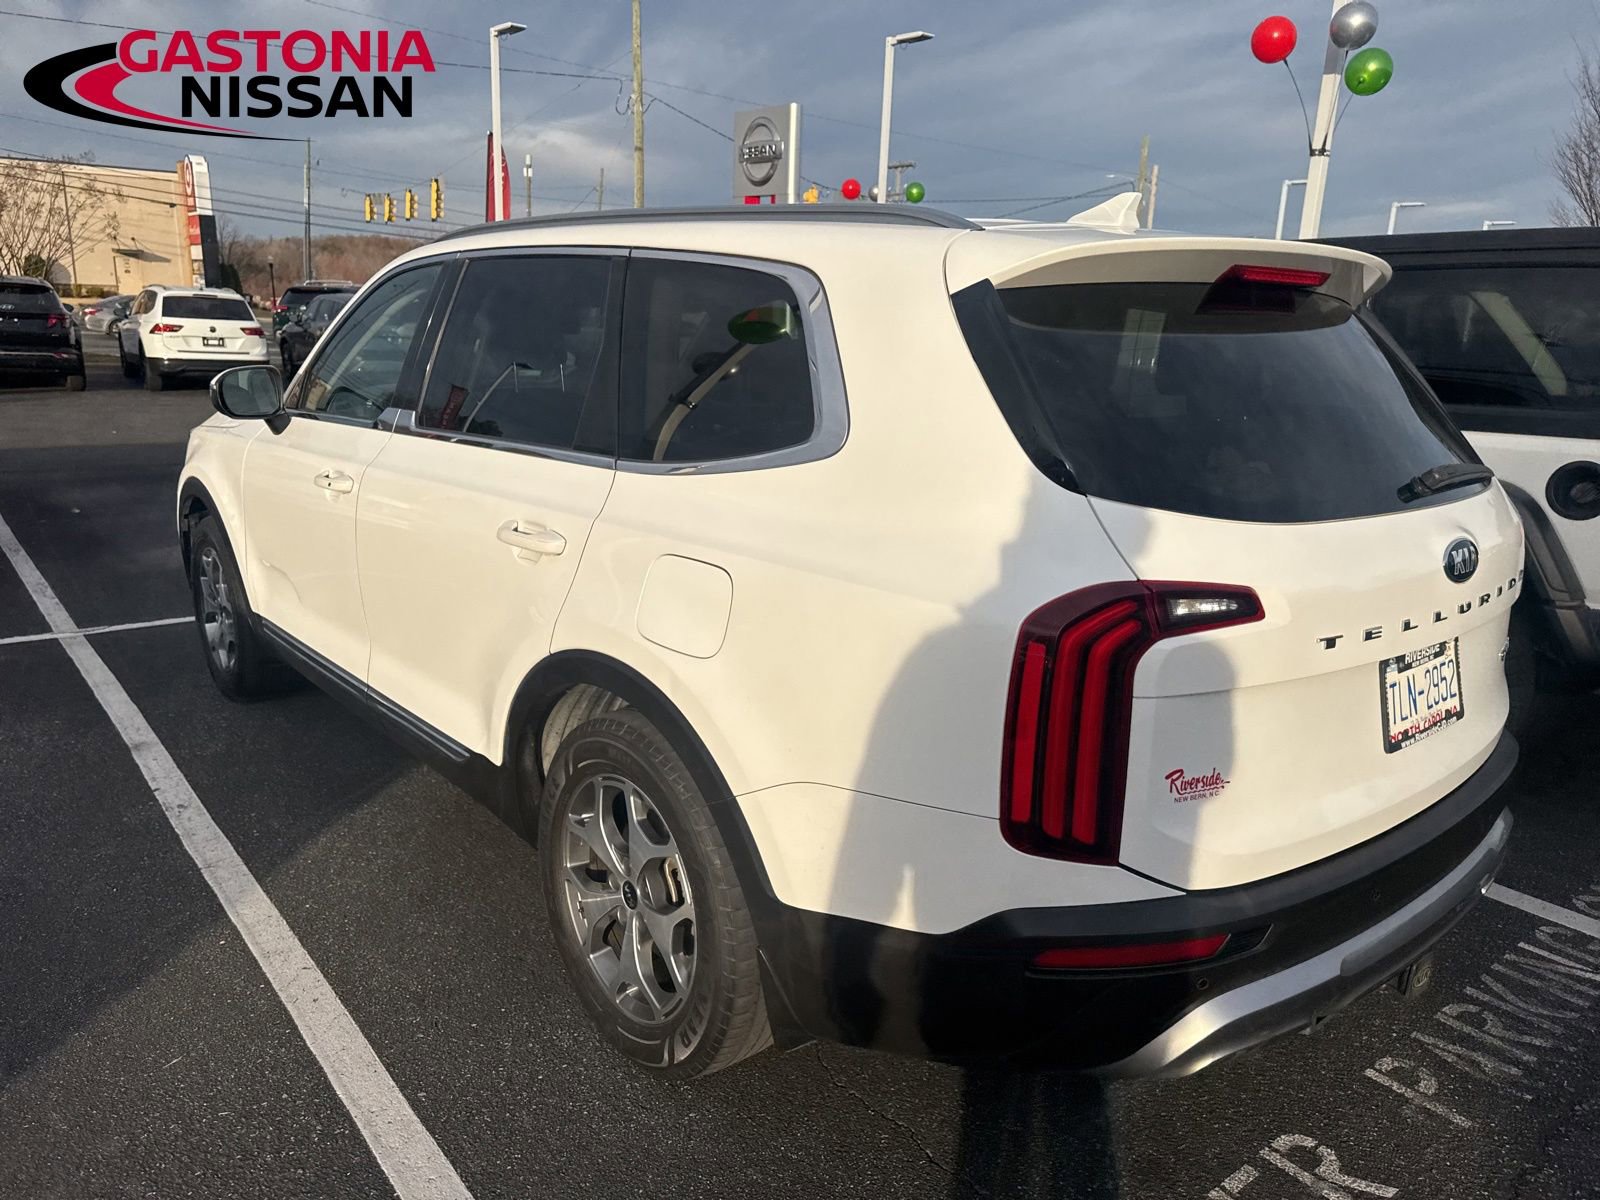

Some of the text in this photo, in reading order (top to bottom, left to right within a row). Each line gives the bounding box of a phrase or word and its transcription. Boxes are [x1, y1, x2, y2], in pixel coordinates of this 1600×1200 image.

[1405, 644, 1440, 665] RIVERSIDE
[1389, 659, 1457, 725] TLN-2952
[1391, 721, 1420, 743] NOTH
[1165, 767, 1224, 795] Riverside
